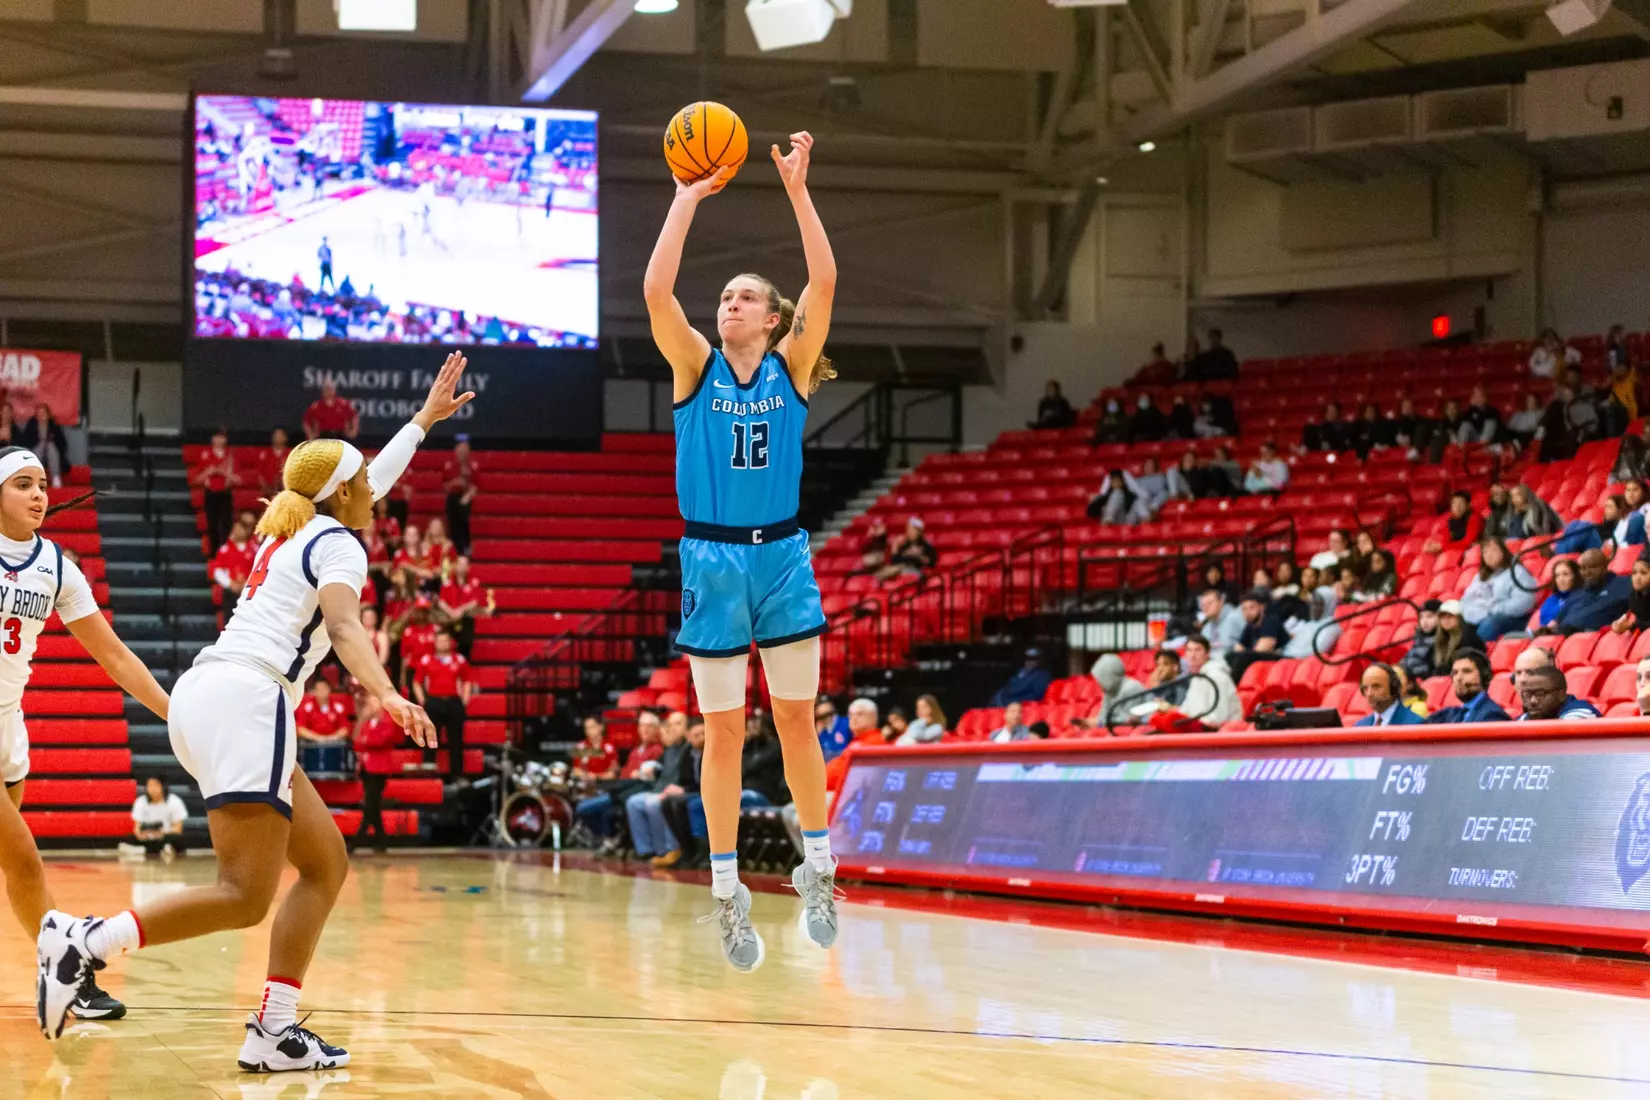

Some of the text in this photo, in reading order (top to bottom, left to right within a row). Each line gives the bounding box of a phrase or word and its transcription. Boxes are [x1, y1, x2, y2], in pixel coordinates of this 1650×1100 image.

[0, 353, 41, 380] AD
[411, 369, 489, 391] FAILY
[711, 394, 785, 417] COLUMBIA
[730, 420, 769, 470] 12
[752, 529, 763, 544] C
[37, 565, 54, 577] CAA
[246, 535, 288, 601] 4
[0, 617, 22, 655] 3
[1382, 764, 1429, 795] FG%
[1478, 765, 1555, 790] OFF REB:
[1369, 810, 1413, 841] FT%
[1461, 816, 1538, 843] DEF REB:
[1344, 854, 1398, 886] 3PT%
[1448, 867, 1519, 888] TURNOVERS:
